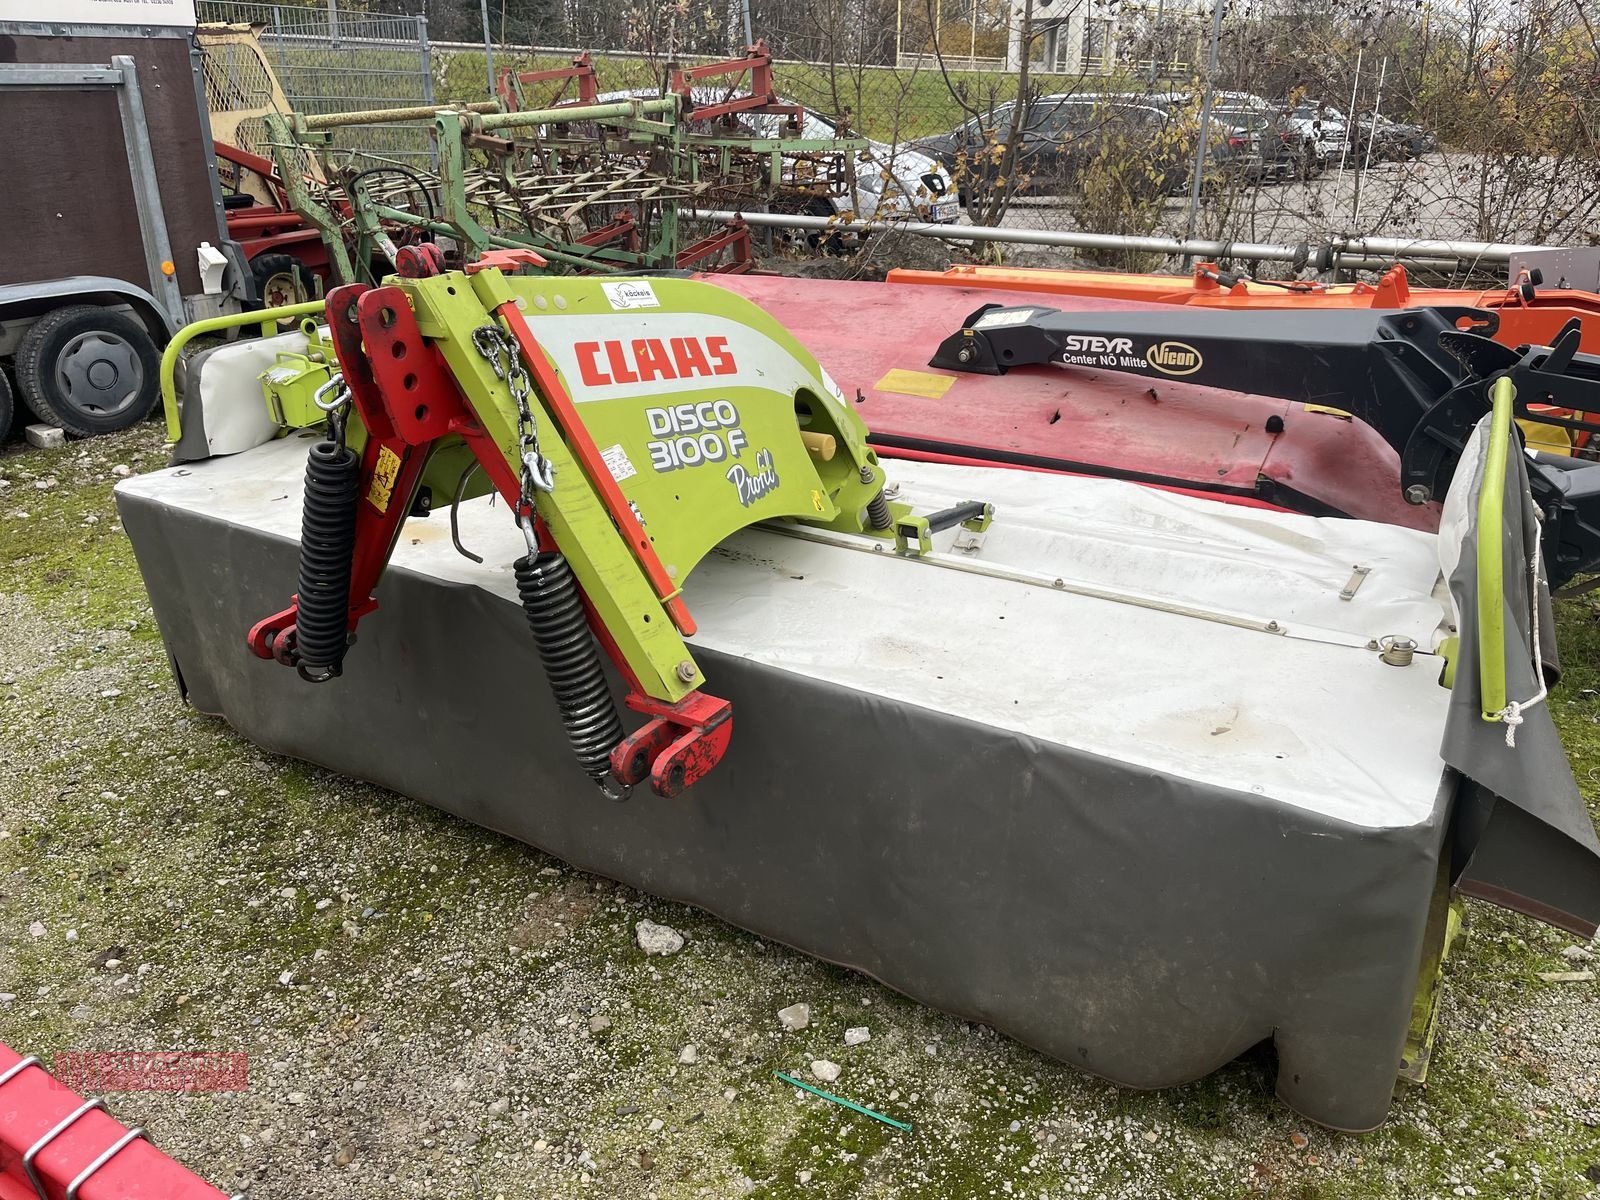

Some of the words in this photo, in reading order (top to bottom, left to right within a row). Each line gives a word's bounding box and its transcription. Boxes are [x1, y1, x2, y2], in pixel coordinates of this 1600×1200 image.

[1062, 352, 1097, 365] Center
[1100, 353, 1118, 367] NÖ
[1120, 356, 1148, 369] Mitte
[1065, 335, 1133, 354] STEYR
[1148, 342, 1197, 367] Vicon
[574, 336, 737, 387] CLAAS
[645, 399, 740, 438] DISCO
[647, 432, 727, 473] 3100
[727, 428, 748, 458] F
